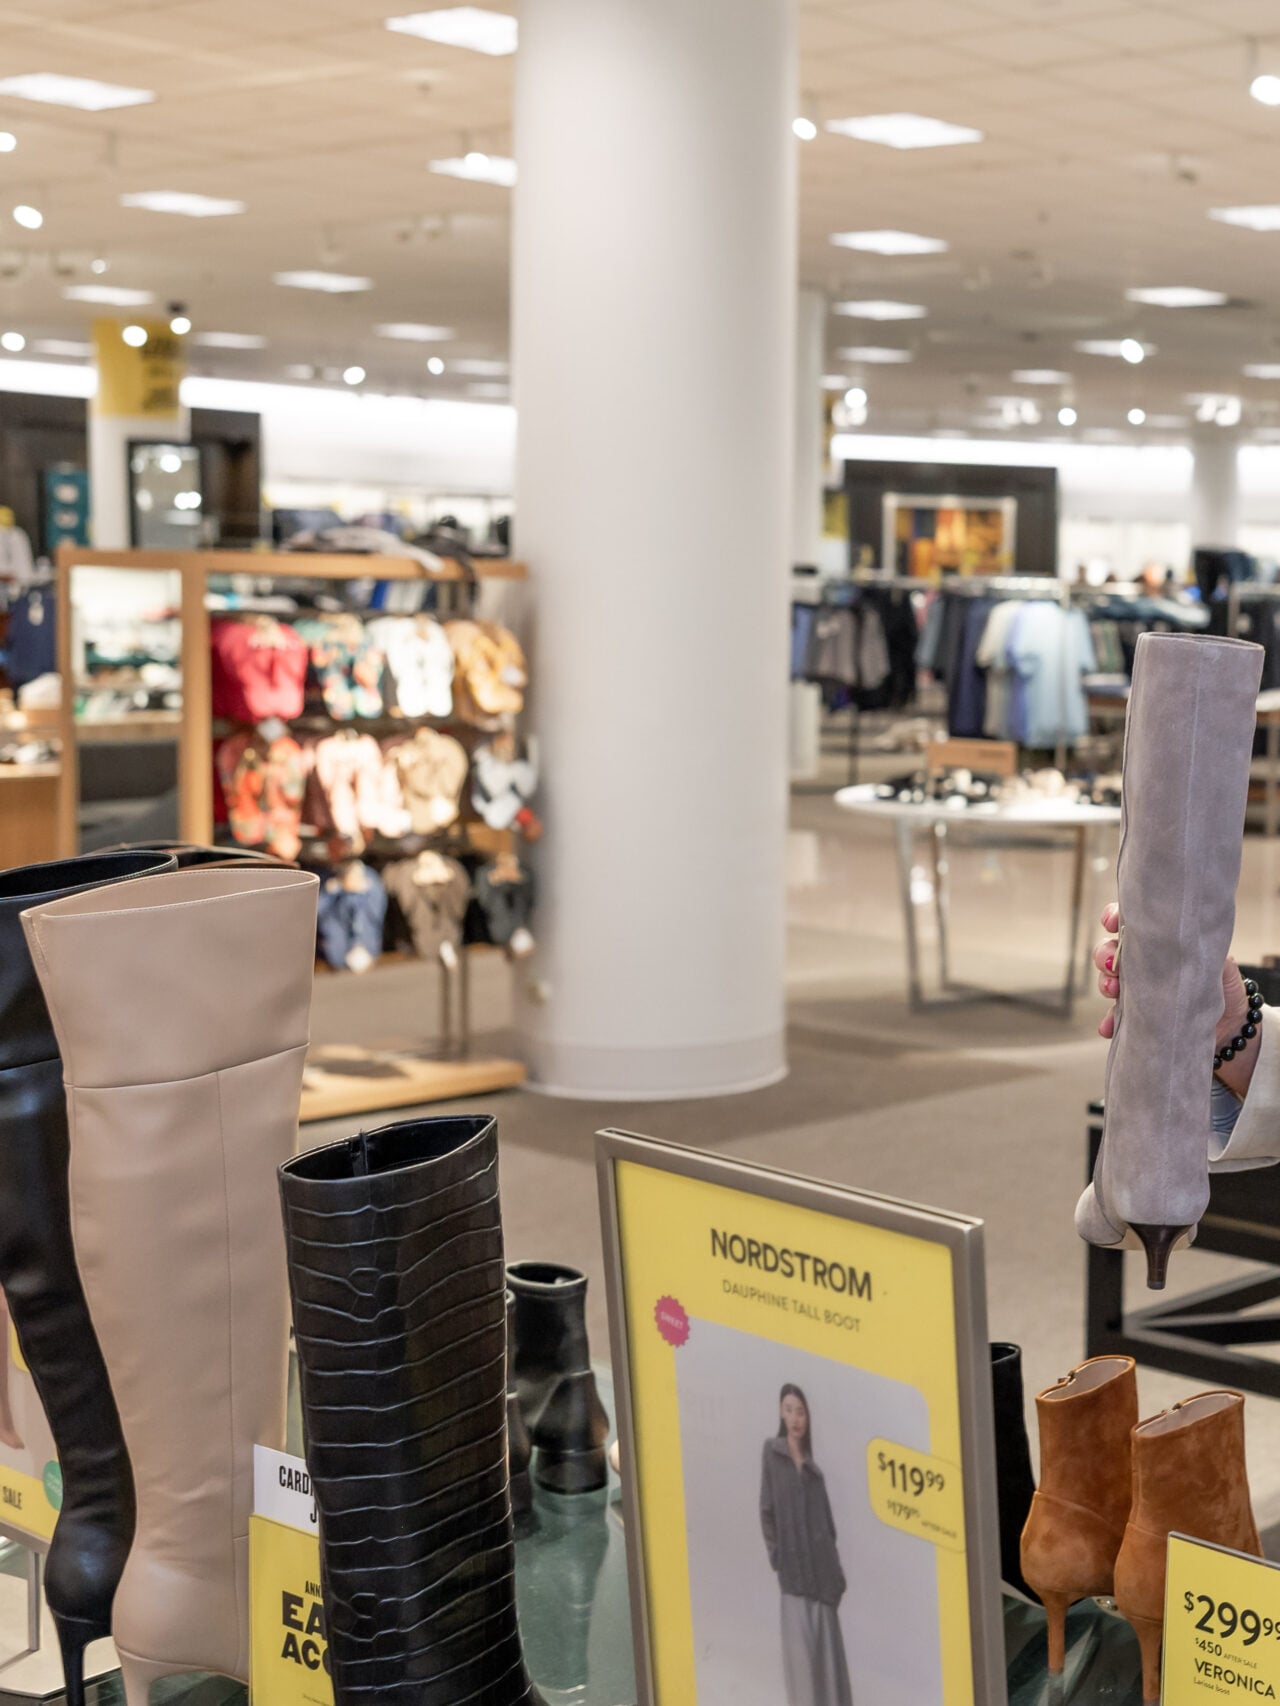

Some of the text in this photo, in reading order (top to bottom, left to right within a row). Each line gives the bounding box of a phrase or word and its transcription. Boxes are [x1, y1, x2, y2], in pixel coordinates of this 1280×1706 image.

[710, 1228, 873, 1302] NORDSTROM
[722, 1279, 861, 1332] DAUPHINE TALL BOOT
[282, 1589, 328, 1641] EA
[304, 1580, 322, 1598] ANN
[1194, 1657, 1277, 1700] VERONICA
